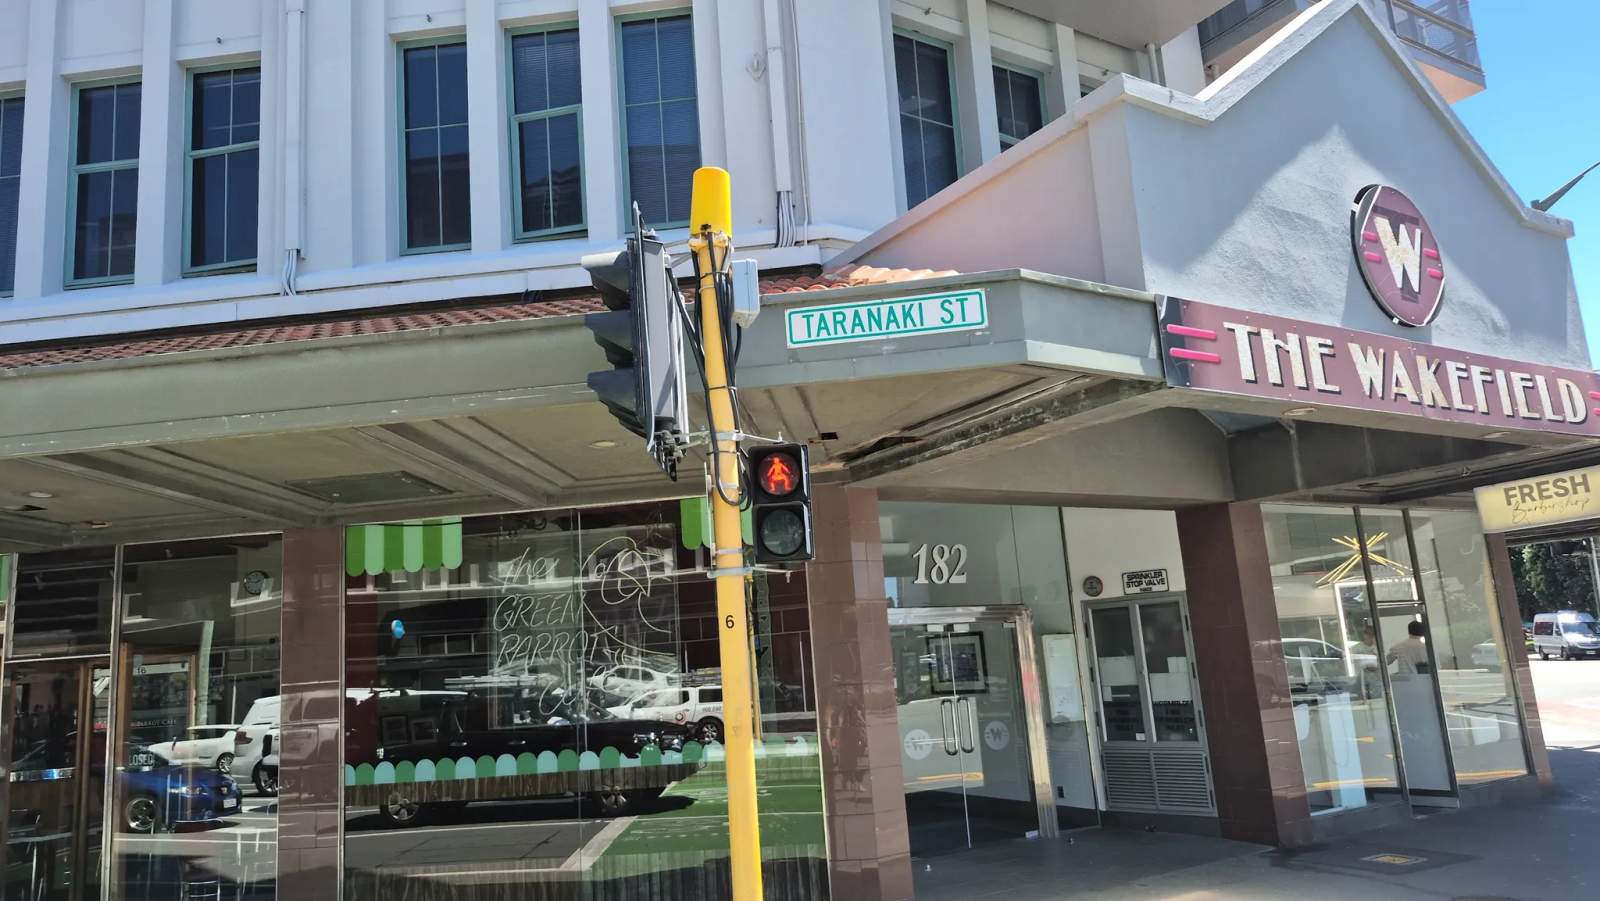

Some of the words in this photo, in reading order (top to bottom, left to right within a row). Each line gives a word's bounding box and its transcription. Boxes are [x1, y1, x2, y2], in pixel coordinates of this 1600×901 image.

[1374, 216, 1421, 292] W
[802, 302, 925, 338] TARANAKI
[940, 298, 968, 324] ST
[1223, 322, 1342, 394] THE
[1347, 342, 1588, 425] WAKEFIELD
[1503, 474, 1591, 506] FRESH
[912, 543, 968, 584] 182
[1126, 571, 1163, 582] SPRINKLER
[1126, 580, 1143, 588] STOP
[1144, 577, 1166, 586] VALVE
[493, 593, 587, 631] GREEN
[725, 614, 735, 629] 6
